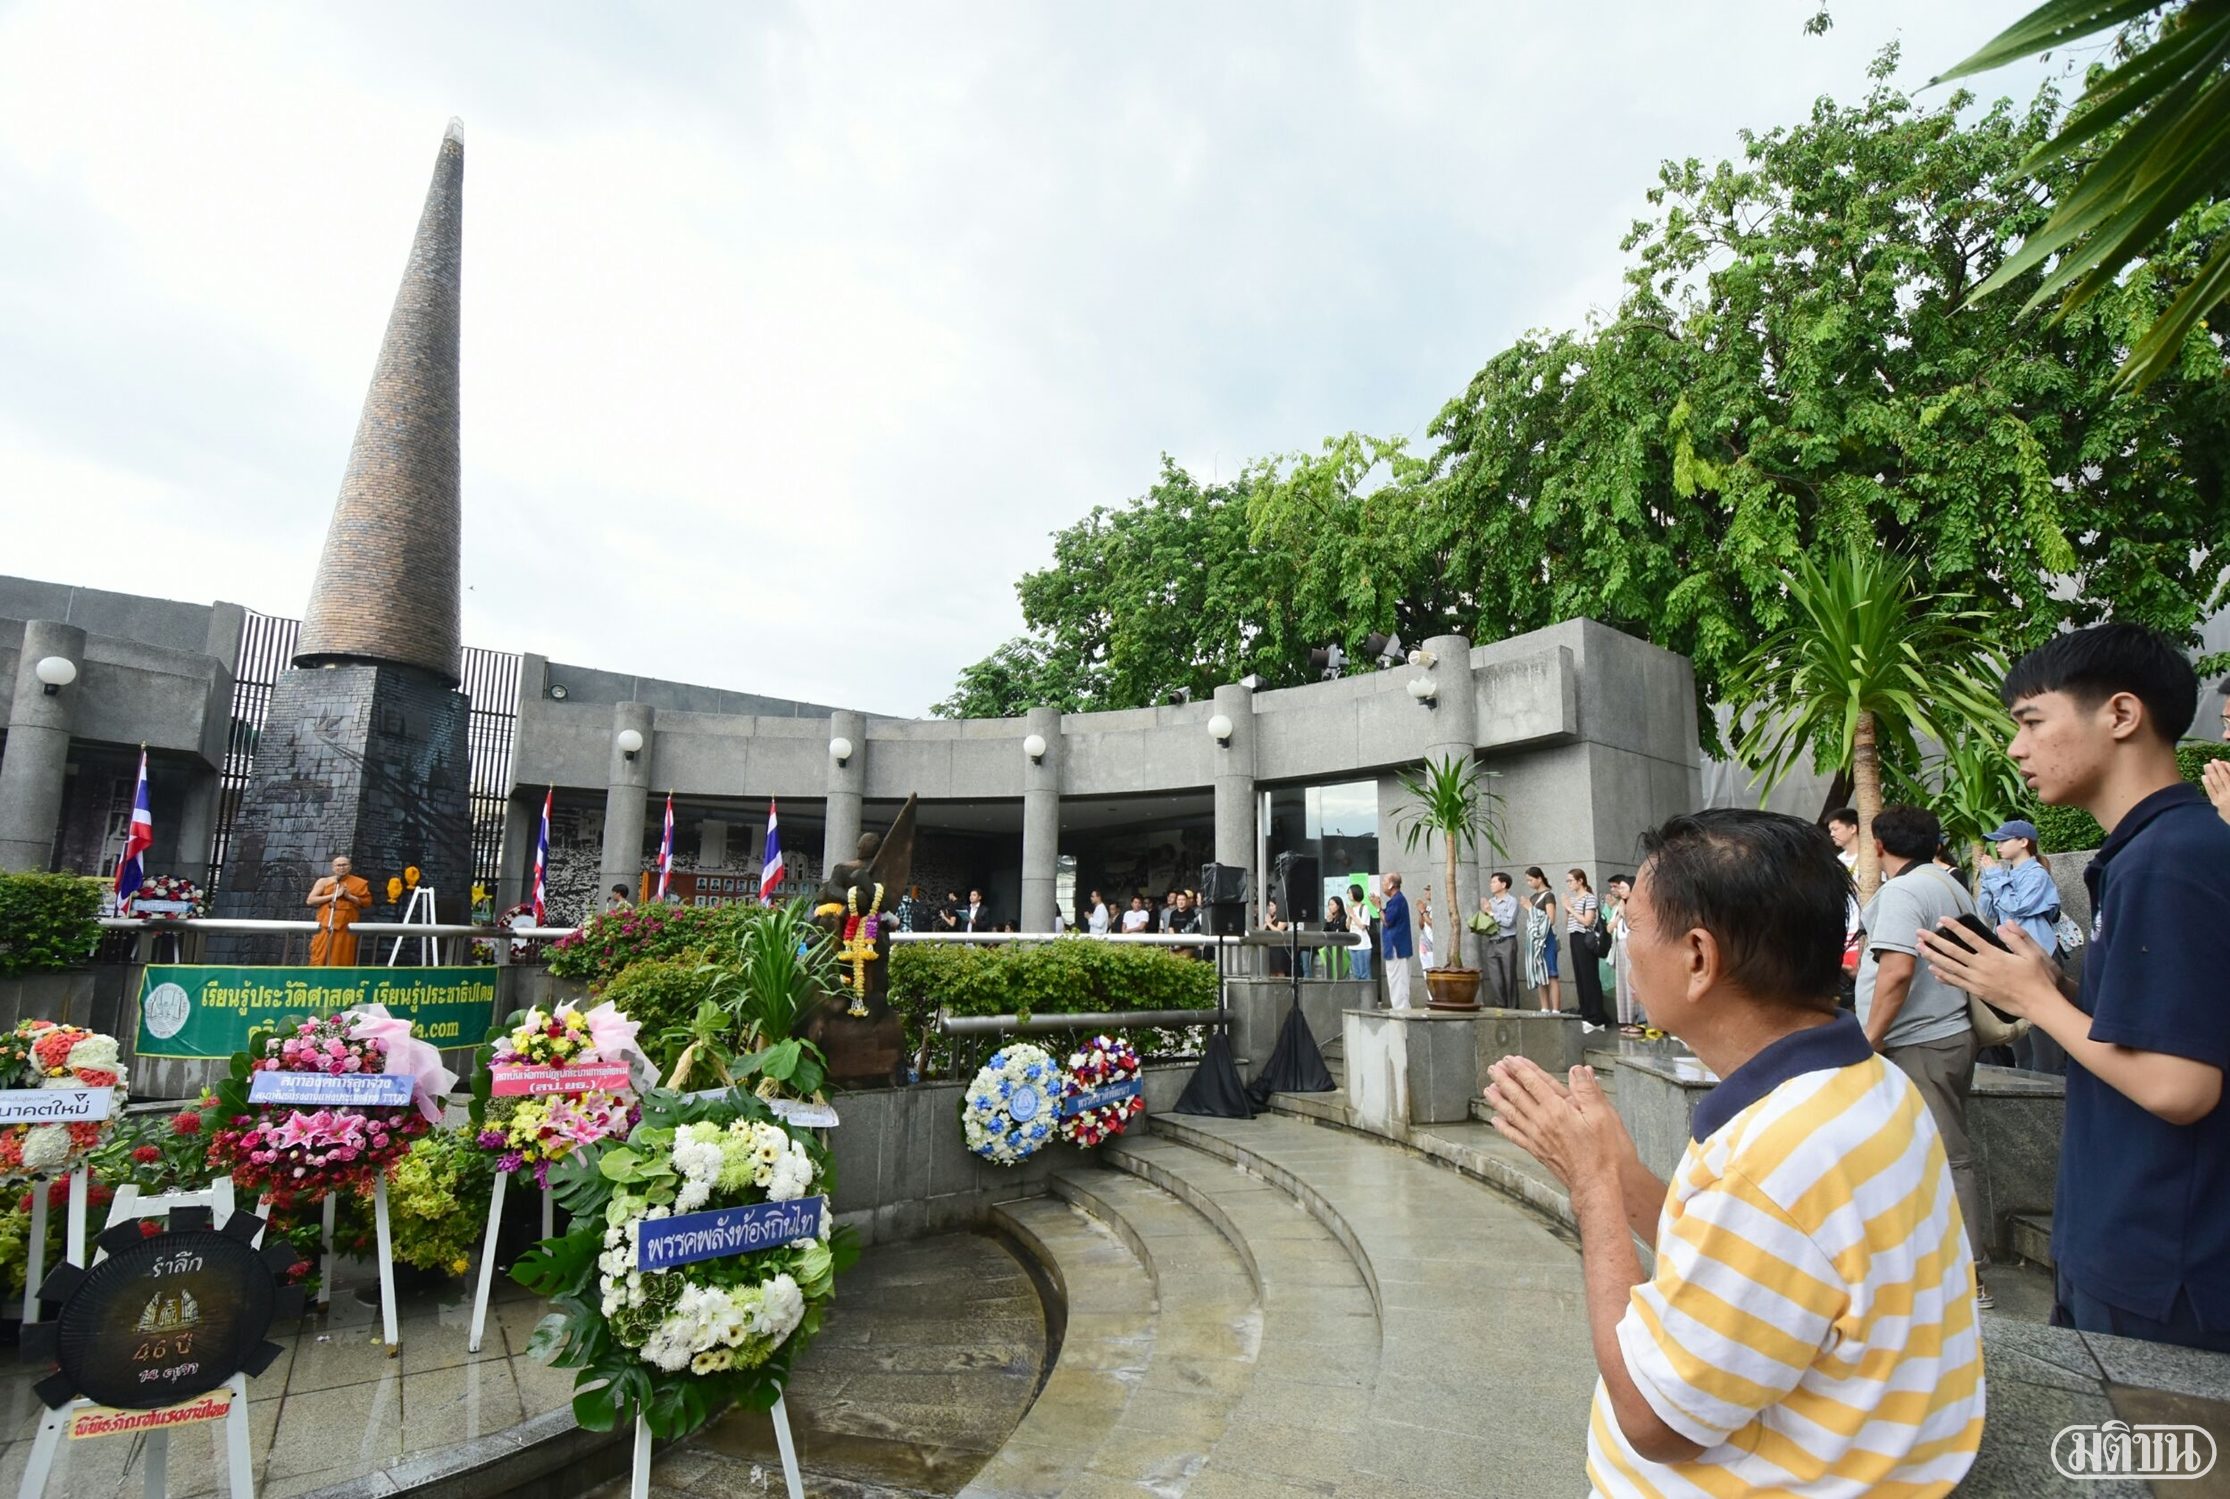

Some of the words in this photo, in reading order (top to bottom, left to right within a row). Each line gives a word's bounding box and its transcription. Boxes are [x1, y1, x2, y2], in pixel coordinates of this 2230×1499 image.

[201, 980, 370, 1016] เรียนรู้ประวัติศาสตร์
[372, 980, 494, 1013] เรียนรู้ประชาธิปไตย
[280, 1074, 392, 1093] สภาองคการลูกจ้าง
[647, 1201, 814, 1262] พรรคพลังท้องถิ่นไท
[152, 1250, 204, 1278] รำลึก
[132, 1339, 167, 1361] 46
[175, 1332, 194, 1354] ปี
